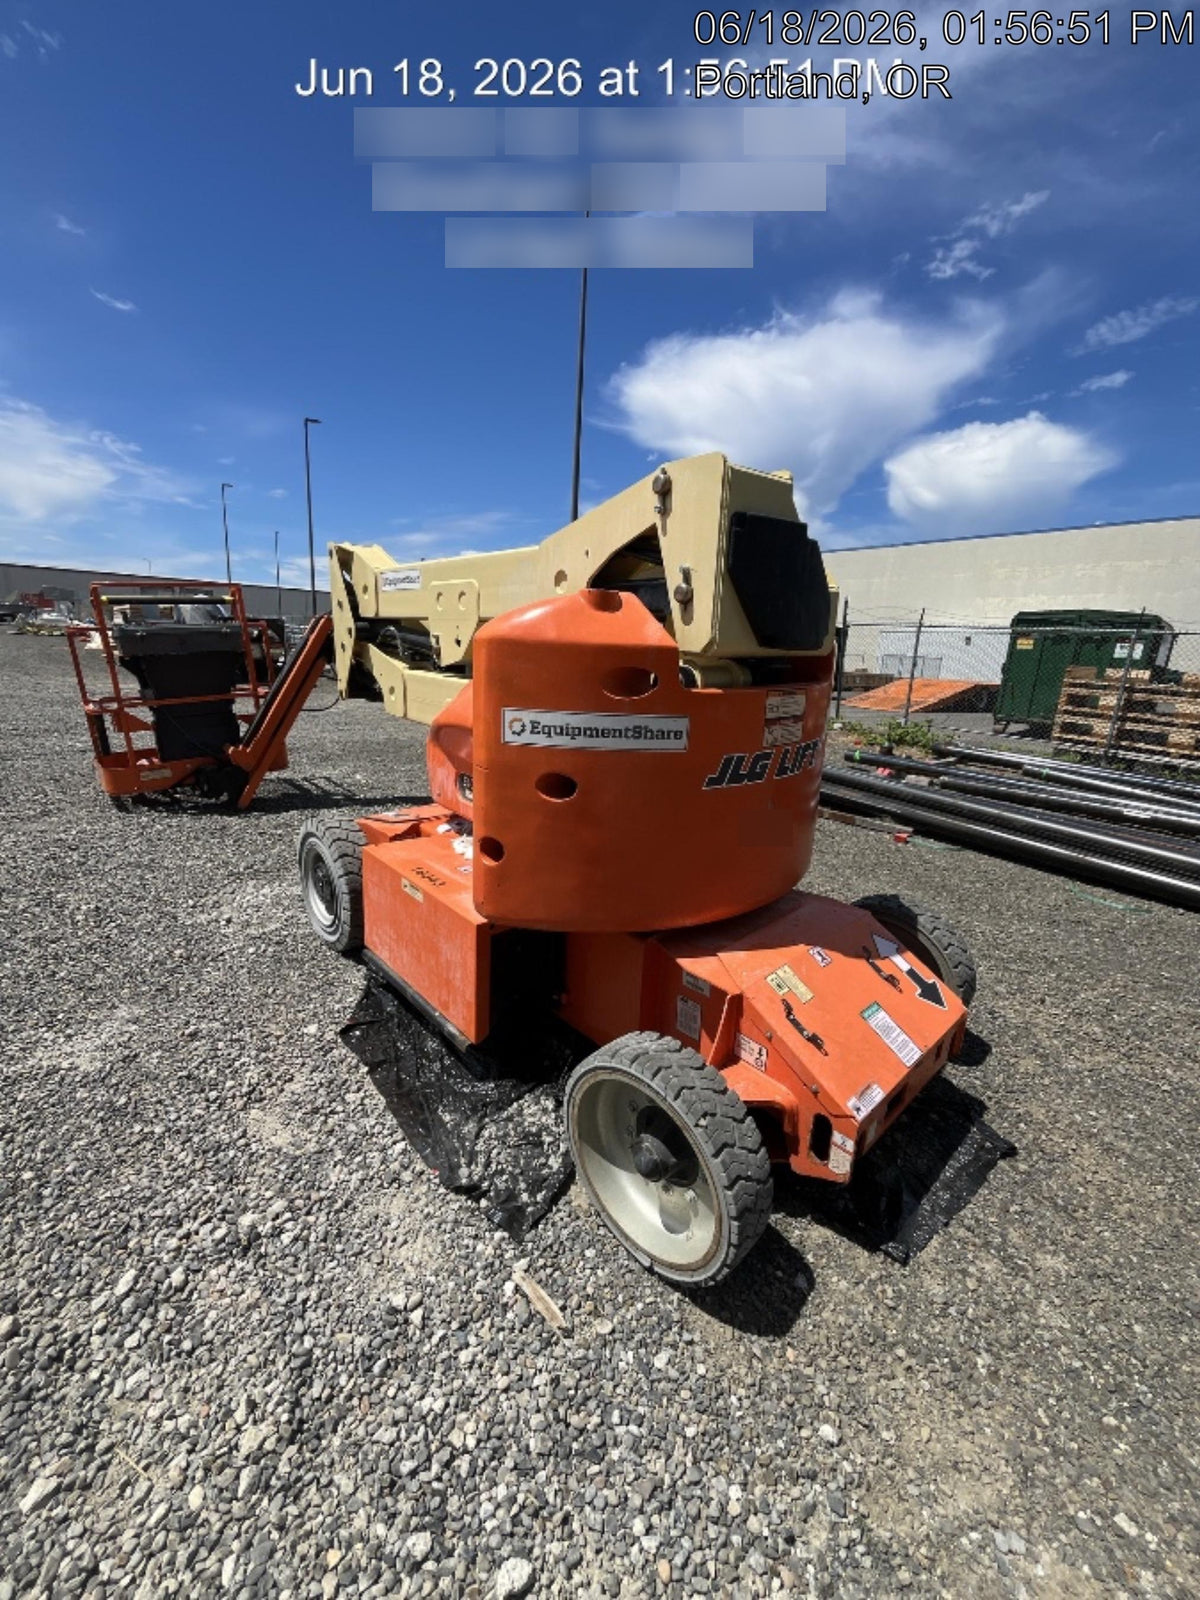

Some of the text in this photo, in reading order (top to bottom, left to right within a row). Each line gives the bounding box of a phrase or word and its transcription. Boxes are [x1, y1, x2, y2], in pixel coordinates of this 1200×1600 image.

[529, 719, 684, 741] EquipmentShare
[702, 737, 821, 790] JLG LIFT
